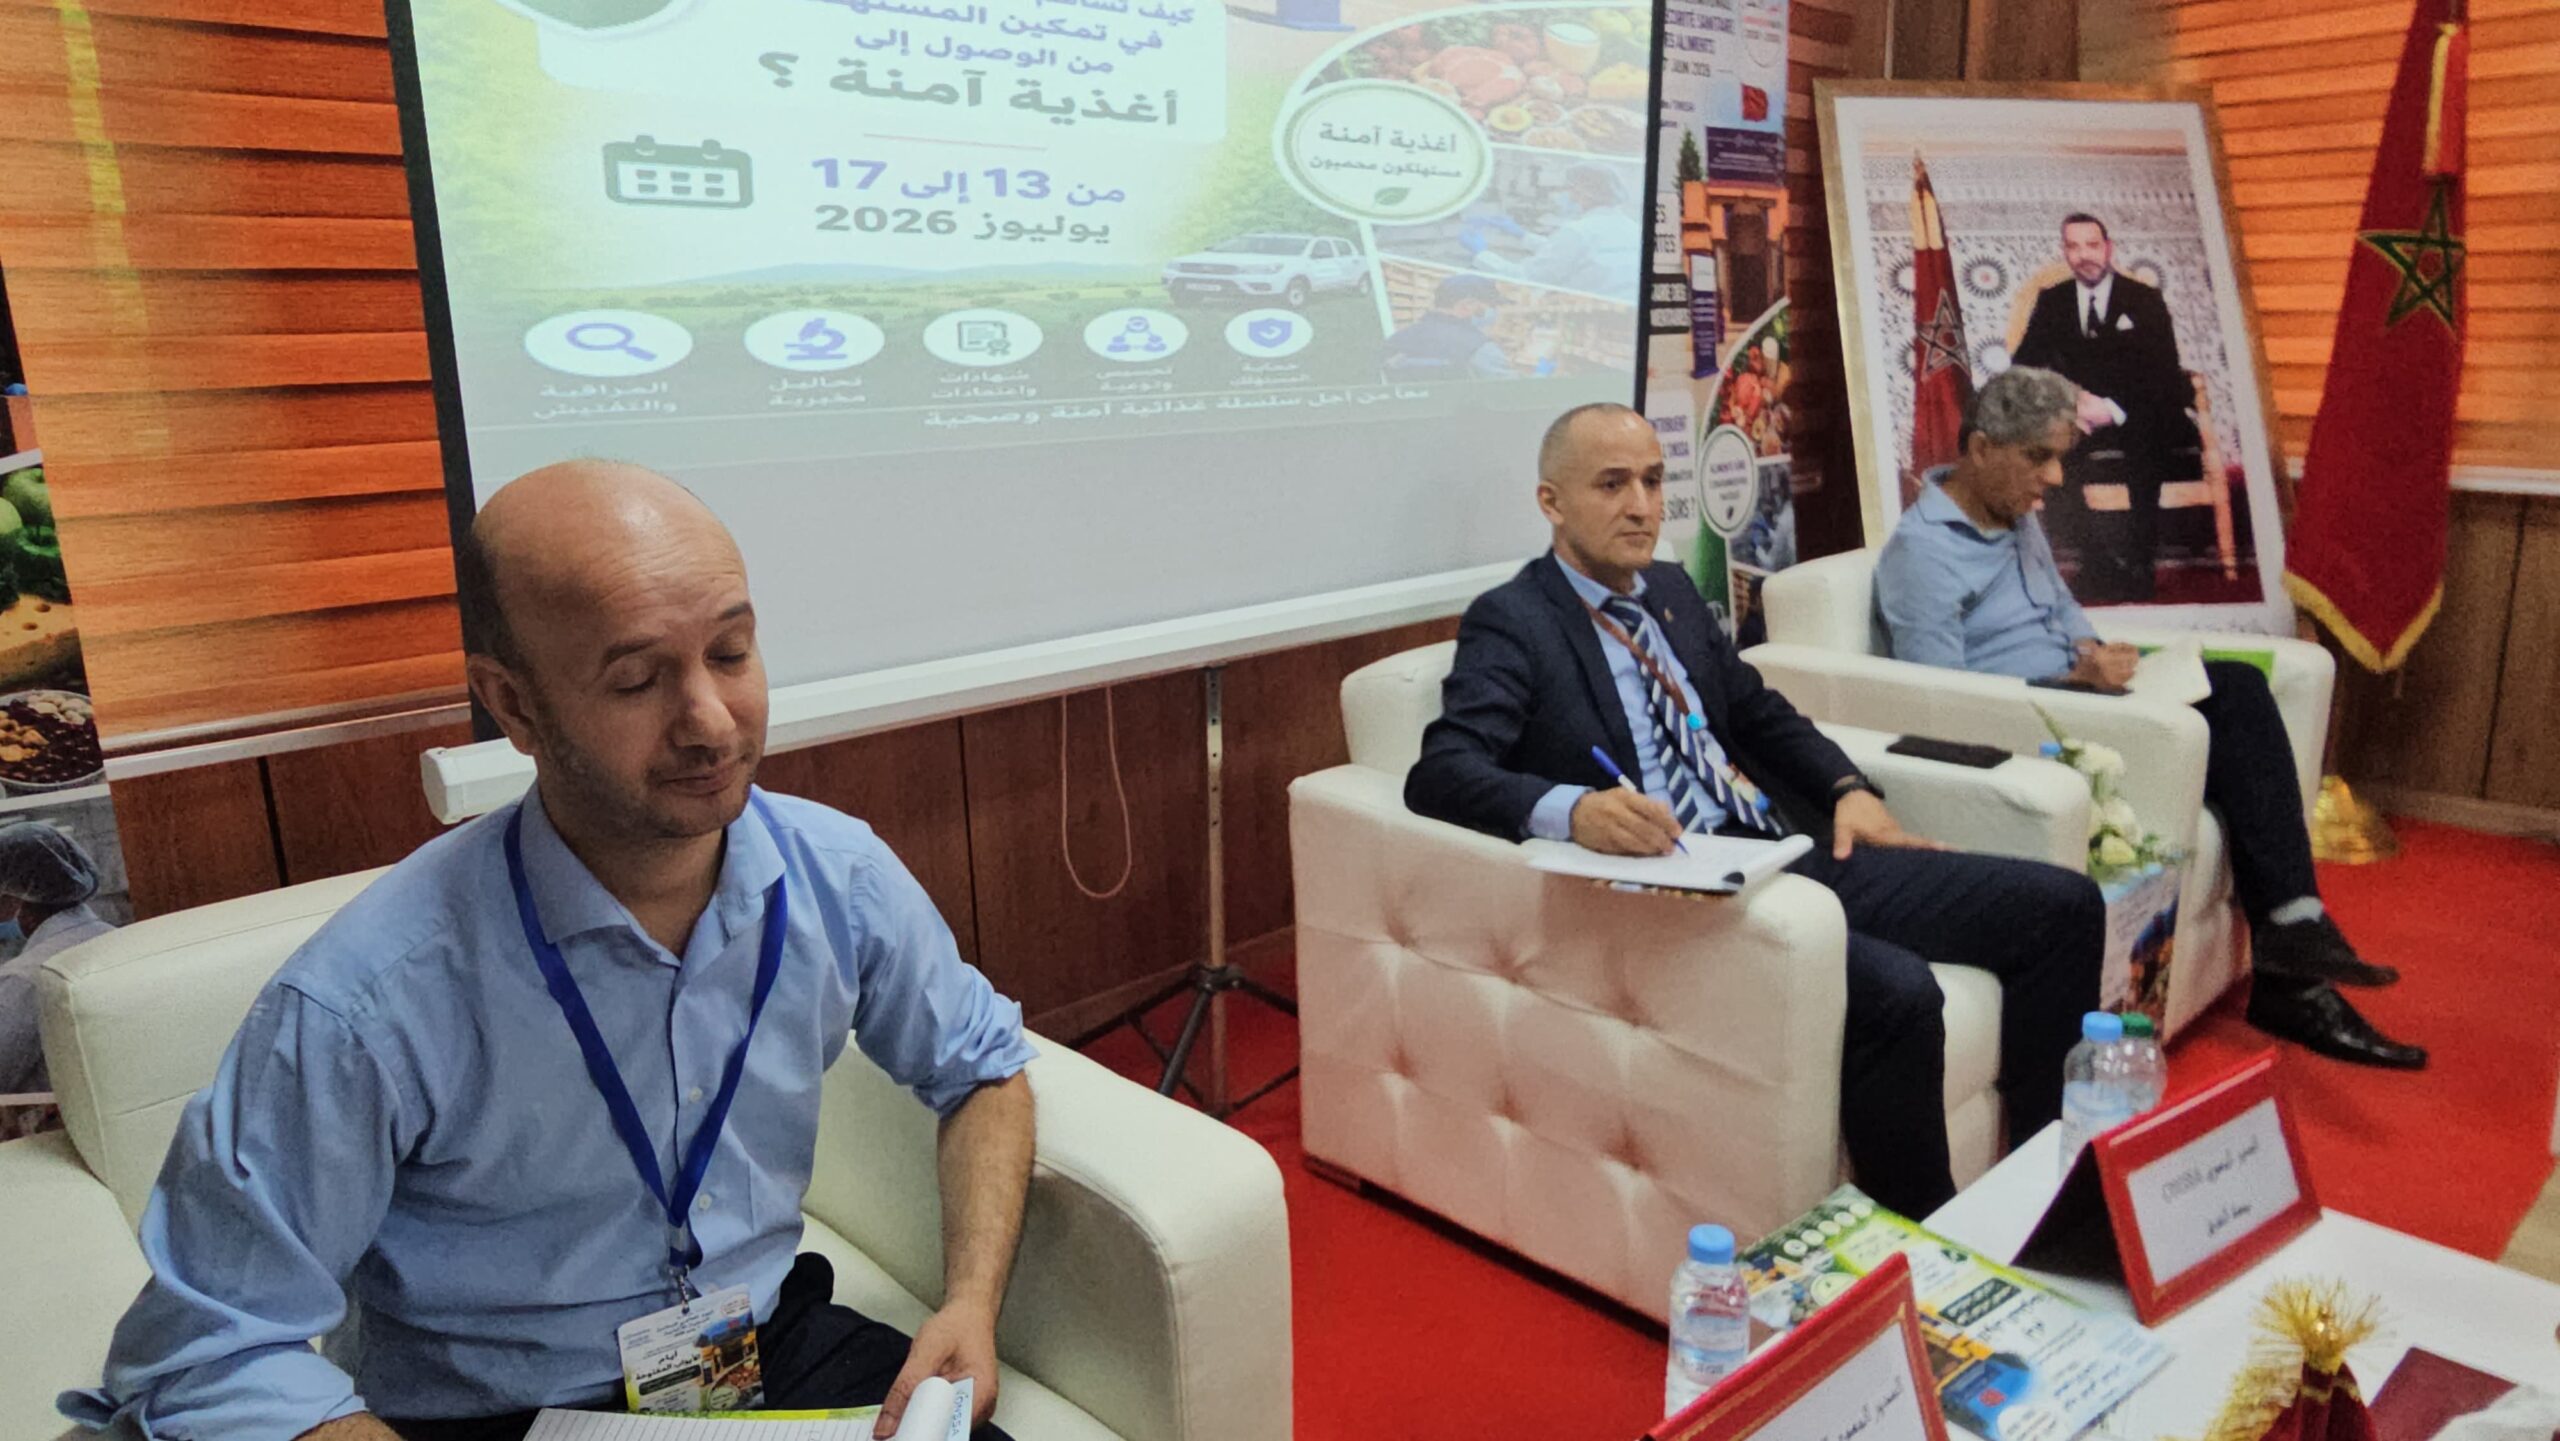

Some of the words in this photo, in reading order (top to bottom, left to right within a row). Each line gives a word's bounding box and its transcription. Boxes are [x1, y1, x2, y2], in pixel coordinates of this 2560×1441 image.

[855, 28, 909, 56] إلى
[1000, 15, 1107, 41] تمكين
[1118, 29, 1162, 56] في
[925, 36, 1058, 68] الوصول
[1067, 56, 1114, 75] من
[758, 51, 799, 88] ؟
[829, 57, 987, 107] آمنة
[1009, 78, 1178, 126] أغذية
[1319, 123, 1382, 146] آمنة
[1390, 130, 1457, 154] أغذية
[811, 157, 888, 190] 17
[1309, 156, 1377, 171] محميون
[900, 170, 970, 204] إلى
[983, 167, 1051, 200] 13
[1066, 183, 1126, 207] من
[815, 204, 958, 235] 2026
[974, 212, 1110, 244] يوليوز
[940, 369, 1030, 384] شهادات
